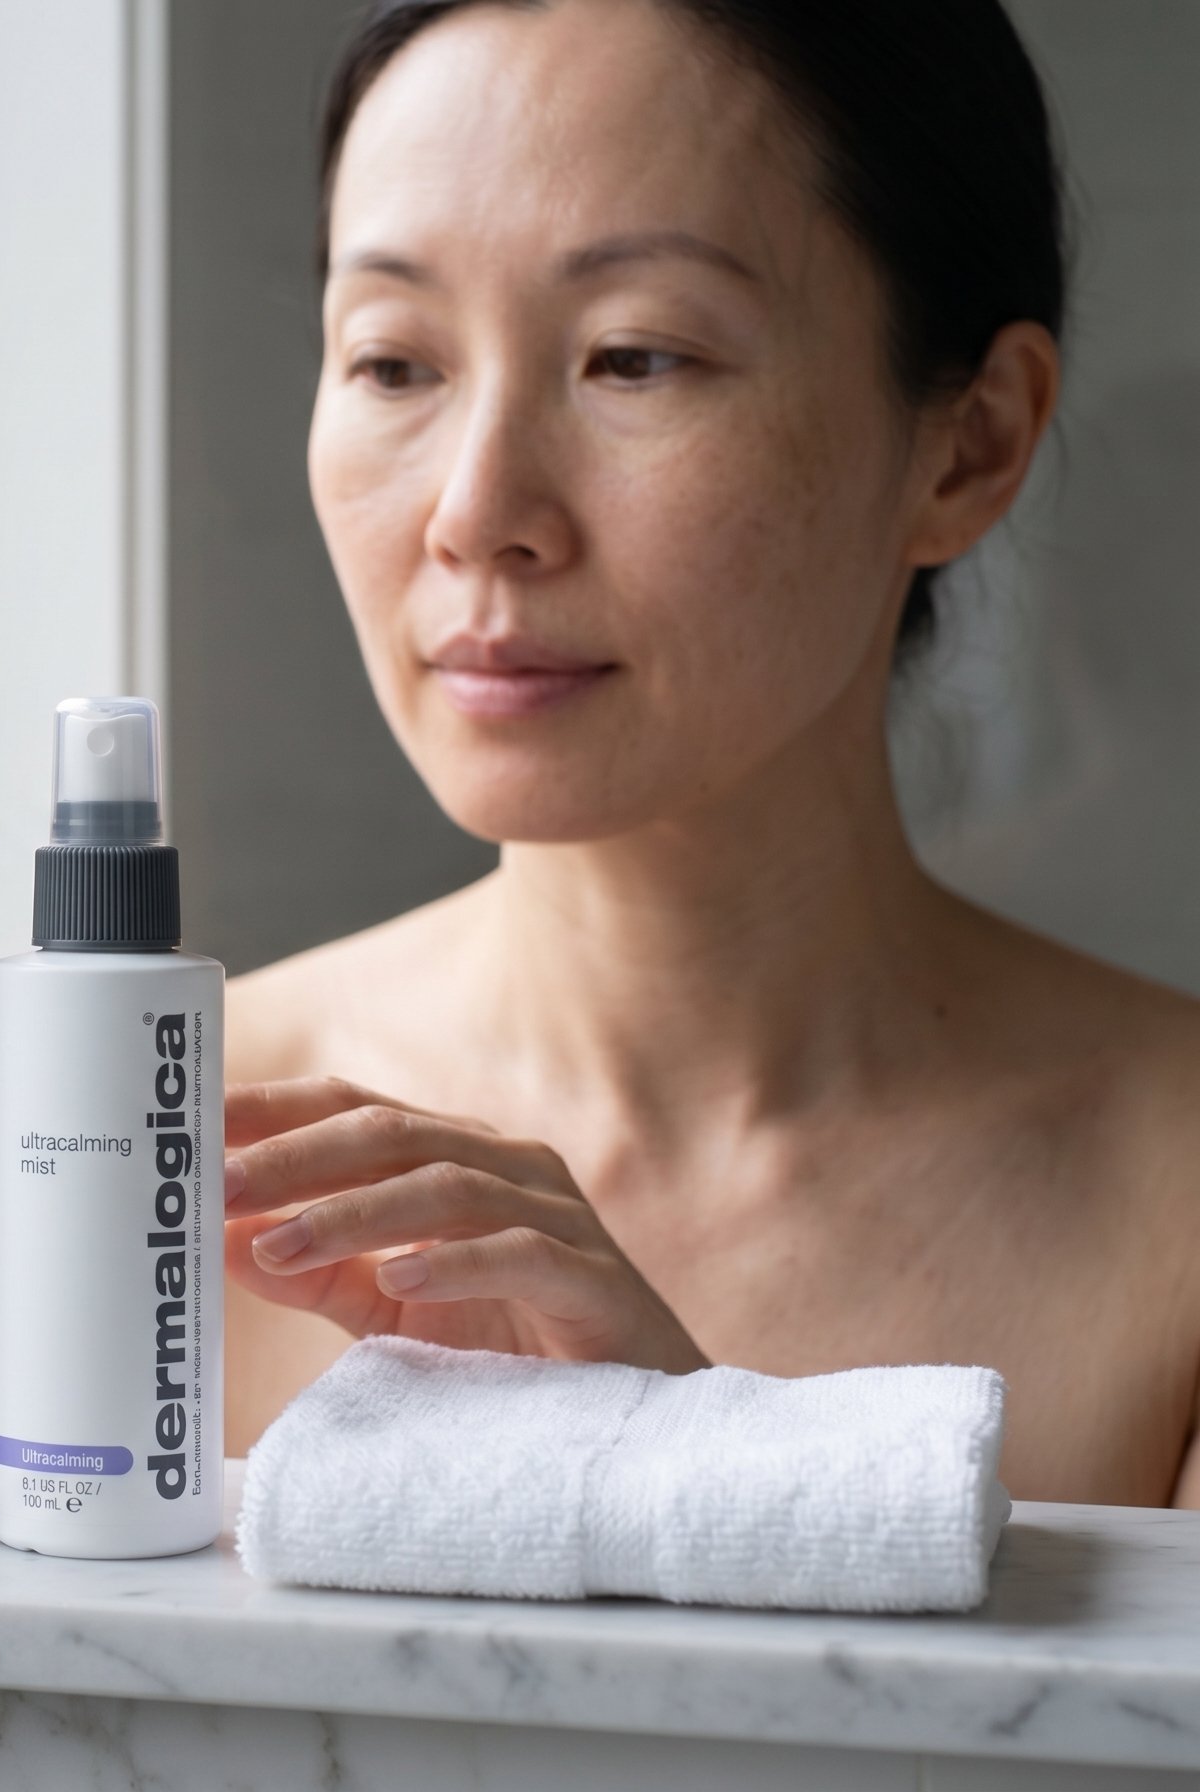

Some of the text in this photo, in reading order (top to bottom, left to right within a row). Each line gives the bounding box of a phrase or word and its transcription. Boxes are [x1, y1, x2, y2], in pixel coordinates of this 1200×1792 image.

[21, 1131, 132, 1157] ultracalming
[21, 1156, 56, 1175] mist
[146, 1012, 192, 1500] dermalogica
[22, 1448, 104, 1471] Ultracalming
[41, 1479, 55, 1493] US
[59, 1481, 73, 1494] FL
[76, 1482, 93, 1495] OZ
[23, 1494, 42, 1508] 100
[45, 1497, 61, 1511] mL
